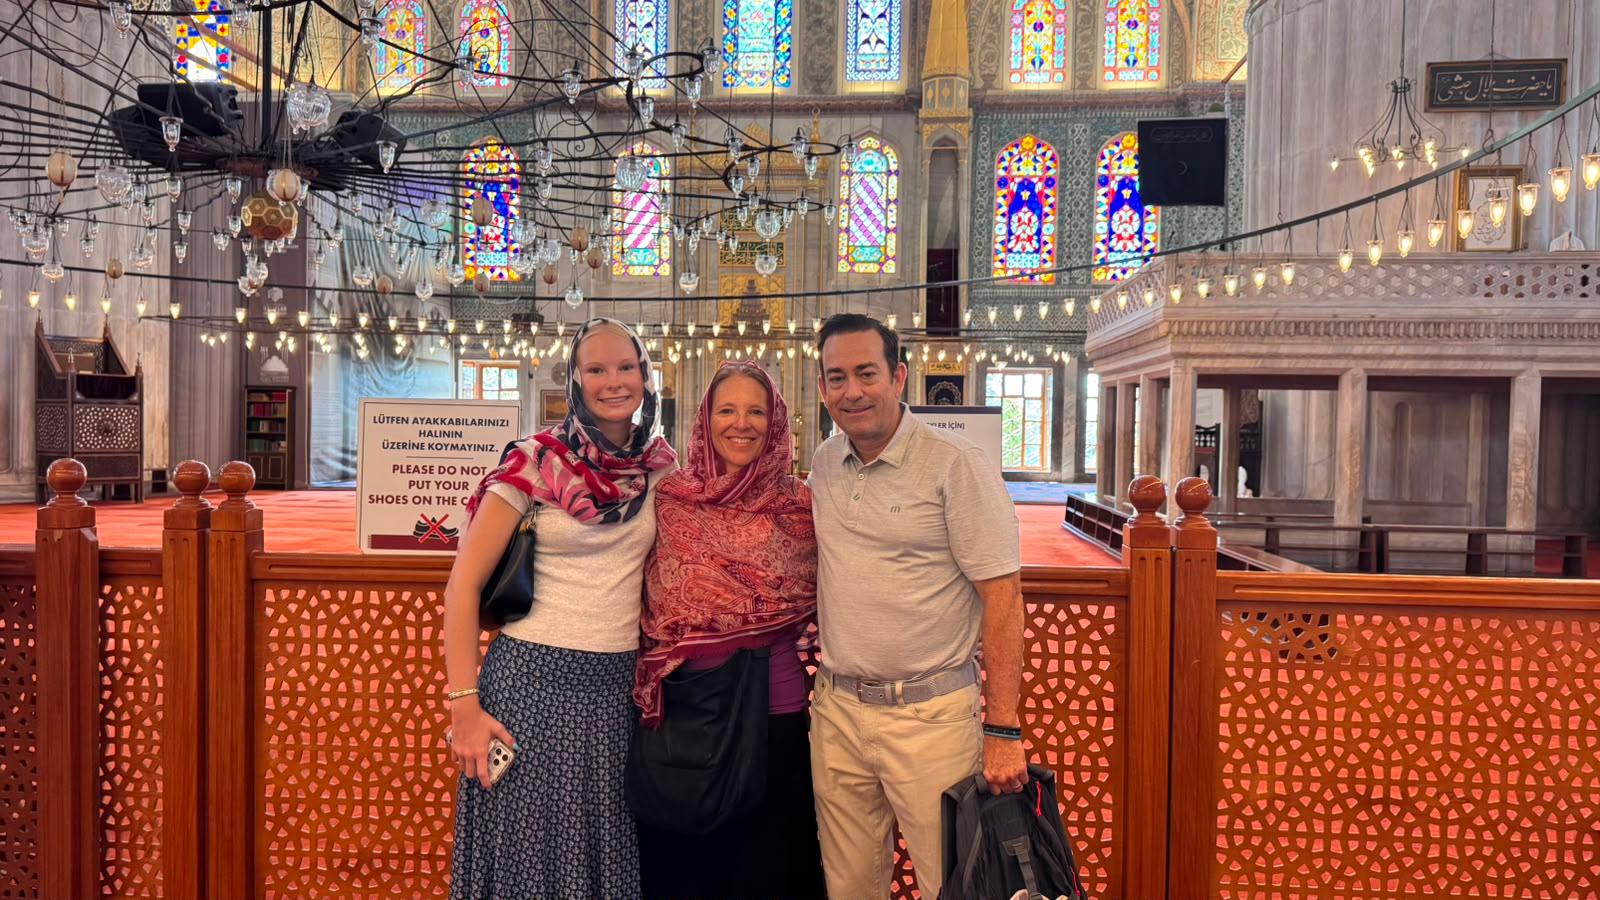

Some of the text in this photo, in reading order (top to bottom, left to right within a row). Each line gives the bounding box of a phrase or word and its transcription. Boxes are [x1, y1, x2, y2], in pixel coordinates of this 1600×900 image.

[373, 414, 509, 427] LÜTFEN AYAKKABILARINIZI
[418, 429, 463, 439] HALININ
[382, 439, 499, 453] ÜZERİNE KOYMAYINIZ.
[392, 464, 488, 476] PLEASE DO NOT
[408, 480, 470, 491] PUT YOUR
[368, 494, 408, 505] SHOES
[412, 495, 432, 505] ON
[435, 496, 458, 506] THE
